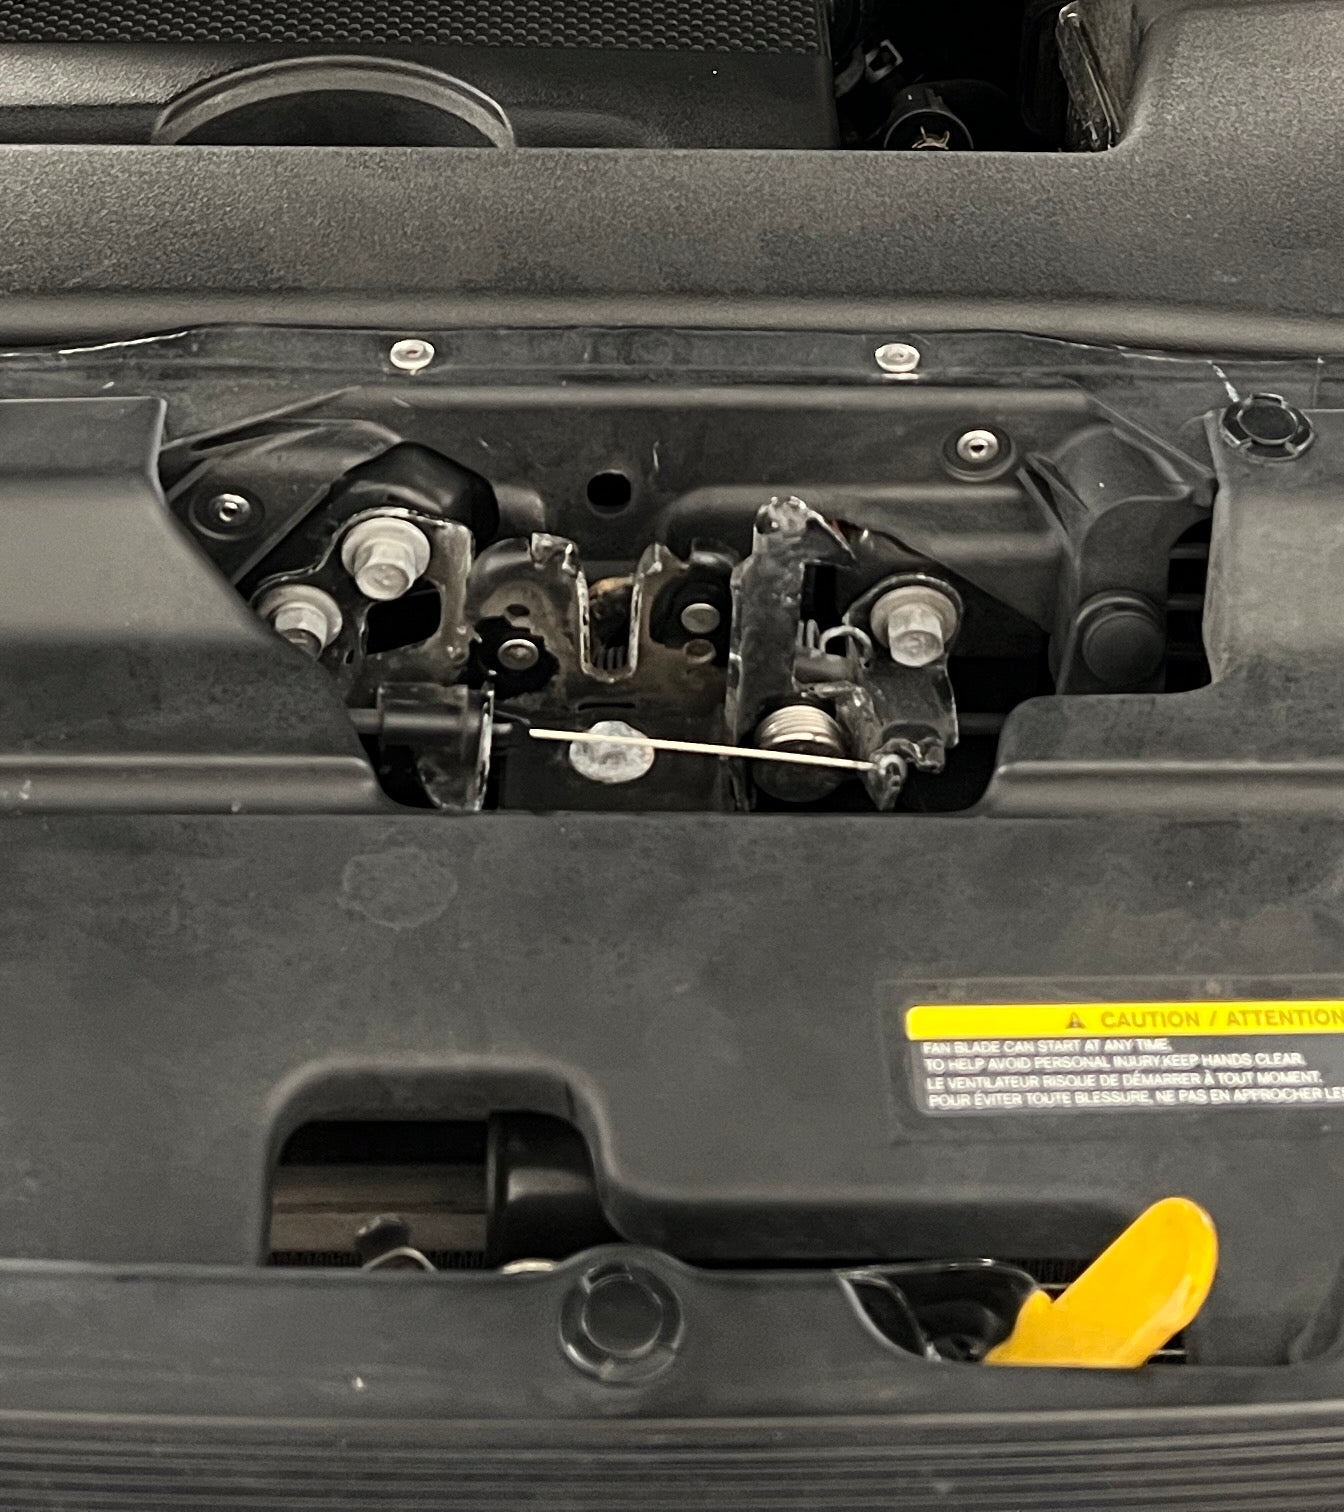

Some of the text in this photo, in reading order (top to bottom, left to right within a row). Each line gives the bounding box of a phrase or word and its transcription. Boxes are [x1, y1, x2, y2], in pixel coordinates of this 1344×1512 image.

[1101, 1010, 1200, 1029] CAUTION
[1209, 1010, 1218, 1027] /
[923, 1041, 951, 1054] FAN
[954, 1040, 1000, 1054] BLADE
[1003, 1040, 1035, 1052] CAN
[1037, 1039, 1081, 1052] START
[1084, 1039, 1100, 1051] AT
[1104, 1038, 1133, 1051] ANY
[924, 1058, 945, 1071] TO
[948, 1057, 985, 1071] HELP
[988, 1057, 1031, 1070] AVOID
[1034, 1055, 1111, 1070] PERSONAL
[1162, 1054, 1200, 1067] KEEP
[1201, 1053, 1253, 1067] HANDS
[926, 1069, 1323, 1090] LE VENTILATEUR RISQUE DE DÉMARRER À TOUT MOMENT.
[928, 1093, 971, 1108] POUR
[974, 1090, 1023, 1107] ÉVITER
[1026, 1091, 1072, 1106] TOUTE
[1156, 1089, 1176, 1103] NE
[1178, 1089, 1207, 1102] PAS
[1210, 1089, 1230, 1102] EN
[1233, 1087, 1323, 1102] APPROCHER
